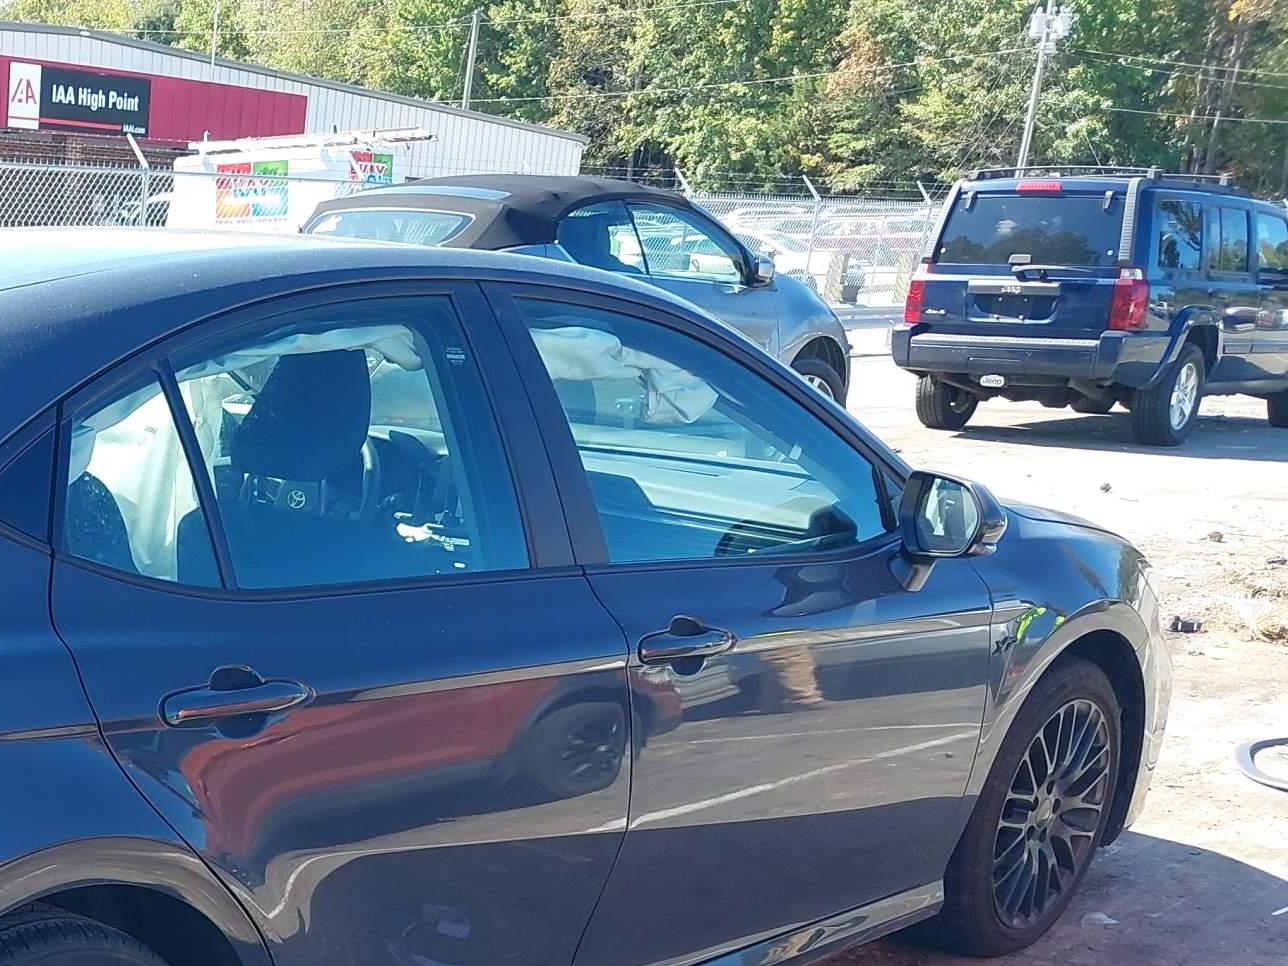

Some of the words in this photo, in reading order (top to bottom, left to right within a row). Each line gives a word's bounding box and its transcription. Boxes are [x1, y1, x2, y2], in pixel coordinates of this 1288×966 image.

[52, 84, 75, 105] IAA
[78, 87, 105, 111] High
[109, 90, 140, 112] Point
[982, 376, 1002, 385] Jeep
